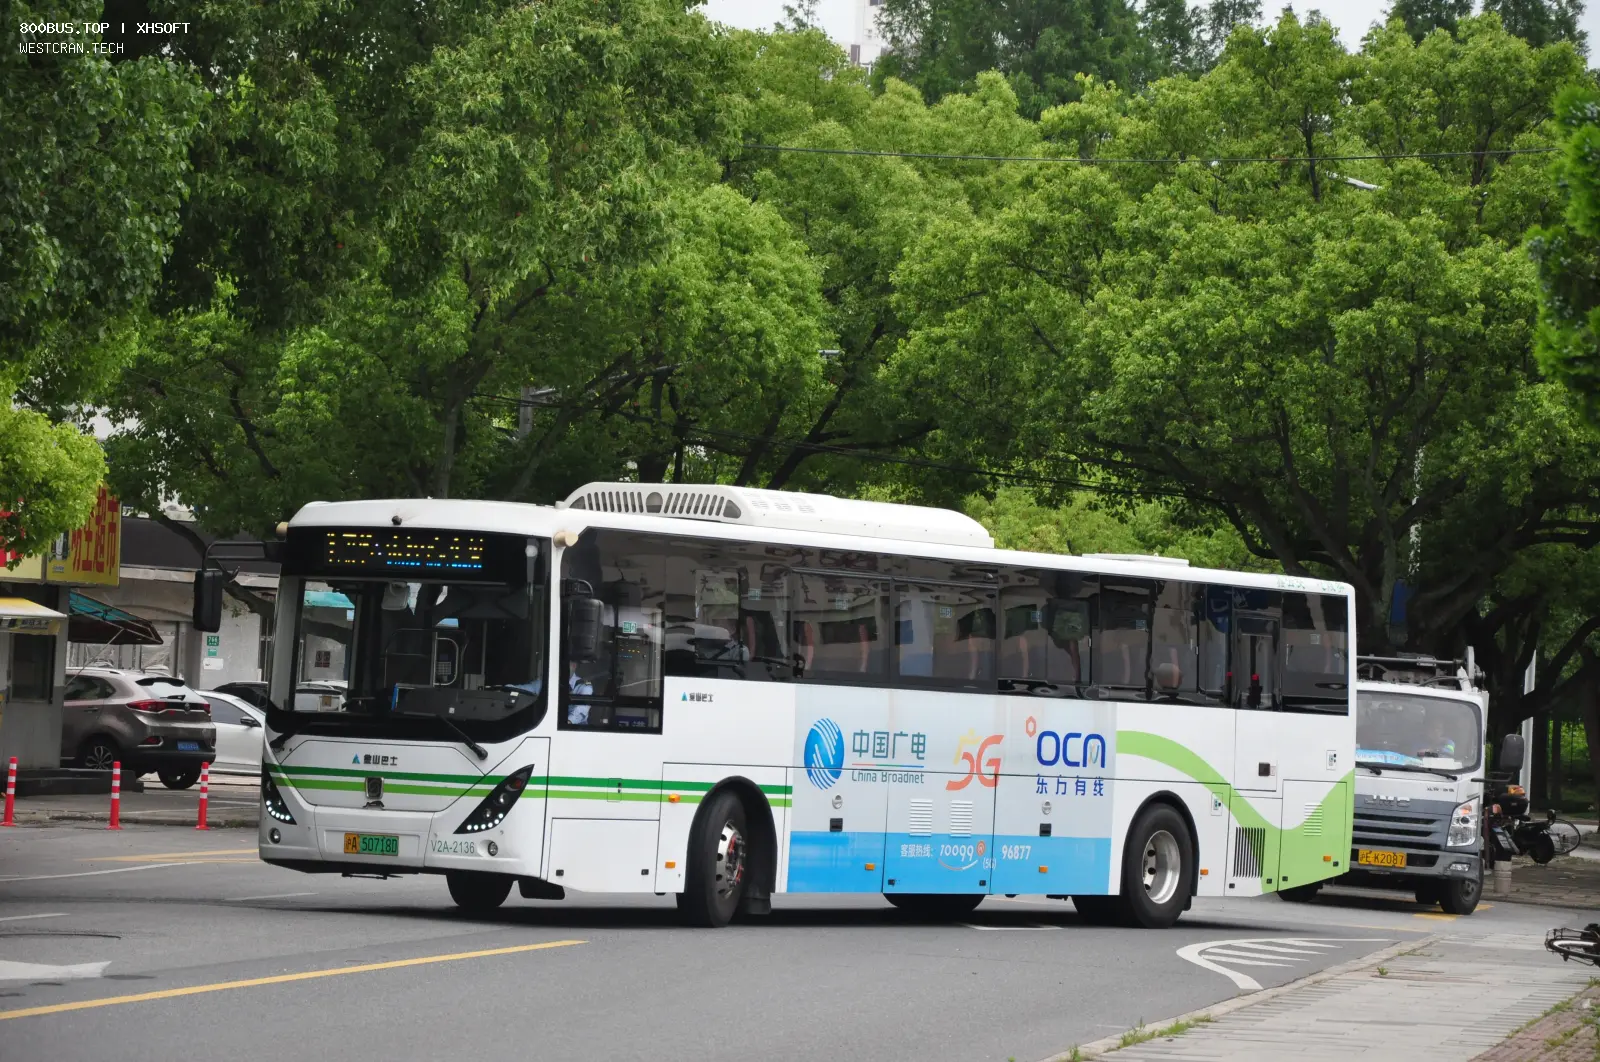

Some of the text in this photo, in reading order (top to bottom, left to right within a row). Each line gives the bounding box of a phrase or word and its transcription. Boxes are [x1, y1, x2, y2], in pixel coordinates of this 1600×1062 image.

[852, 729, 926, 760] 中国广电
[363, 754, 398, 766] 金山巴士
[946, 728, 1004, 791] 5G
[851, 770, 925, 784] China Broadnet
[1035, 774, 1105, 797] 东方有线
[430, 839, 475, 854] V2A-2136
[939, 844, 974, 862] 10099
[1001, 845, 1031, 860] 96877
